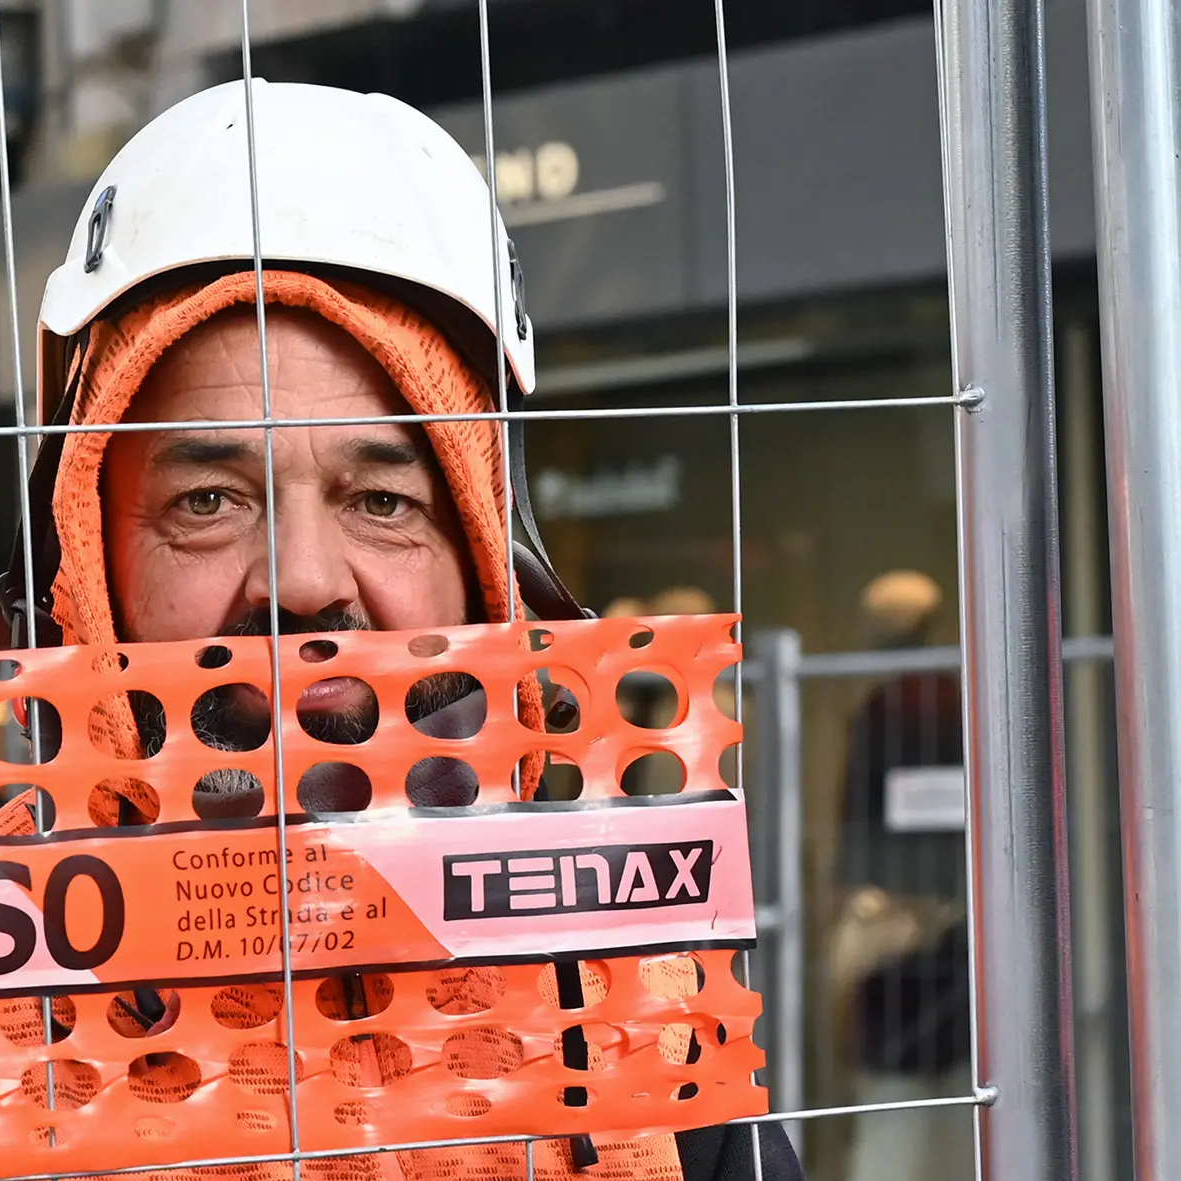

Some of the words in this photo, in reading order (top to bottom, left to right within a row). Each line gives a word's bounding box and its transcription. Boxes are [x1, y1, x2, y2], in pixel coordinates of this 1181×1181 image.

[173, 848, 293, 870] Conforme
[305, 844, 327, 862] al
[176, 880, 253, 901] Nuovo
[263, 872, 354, 894] Codice
[451, 847, 704, 912] TENAX
[178, 909, 235, 932] della
[341, 906, 354, 920] e
[366, 897, 387, 919] al
[176, 940, 230, 961] D.M.
